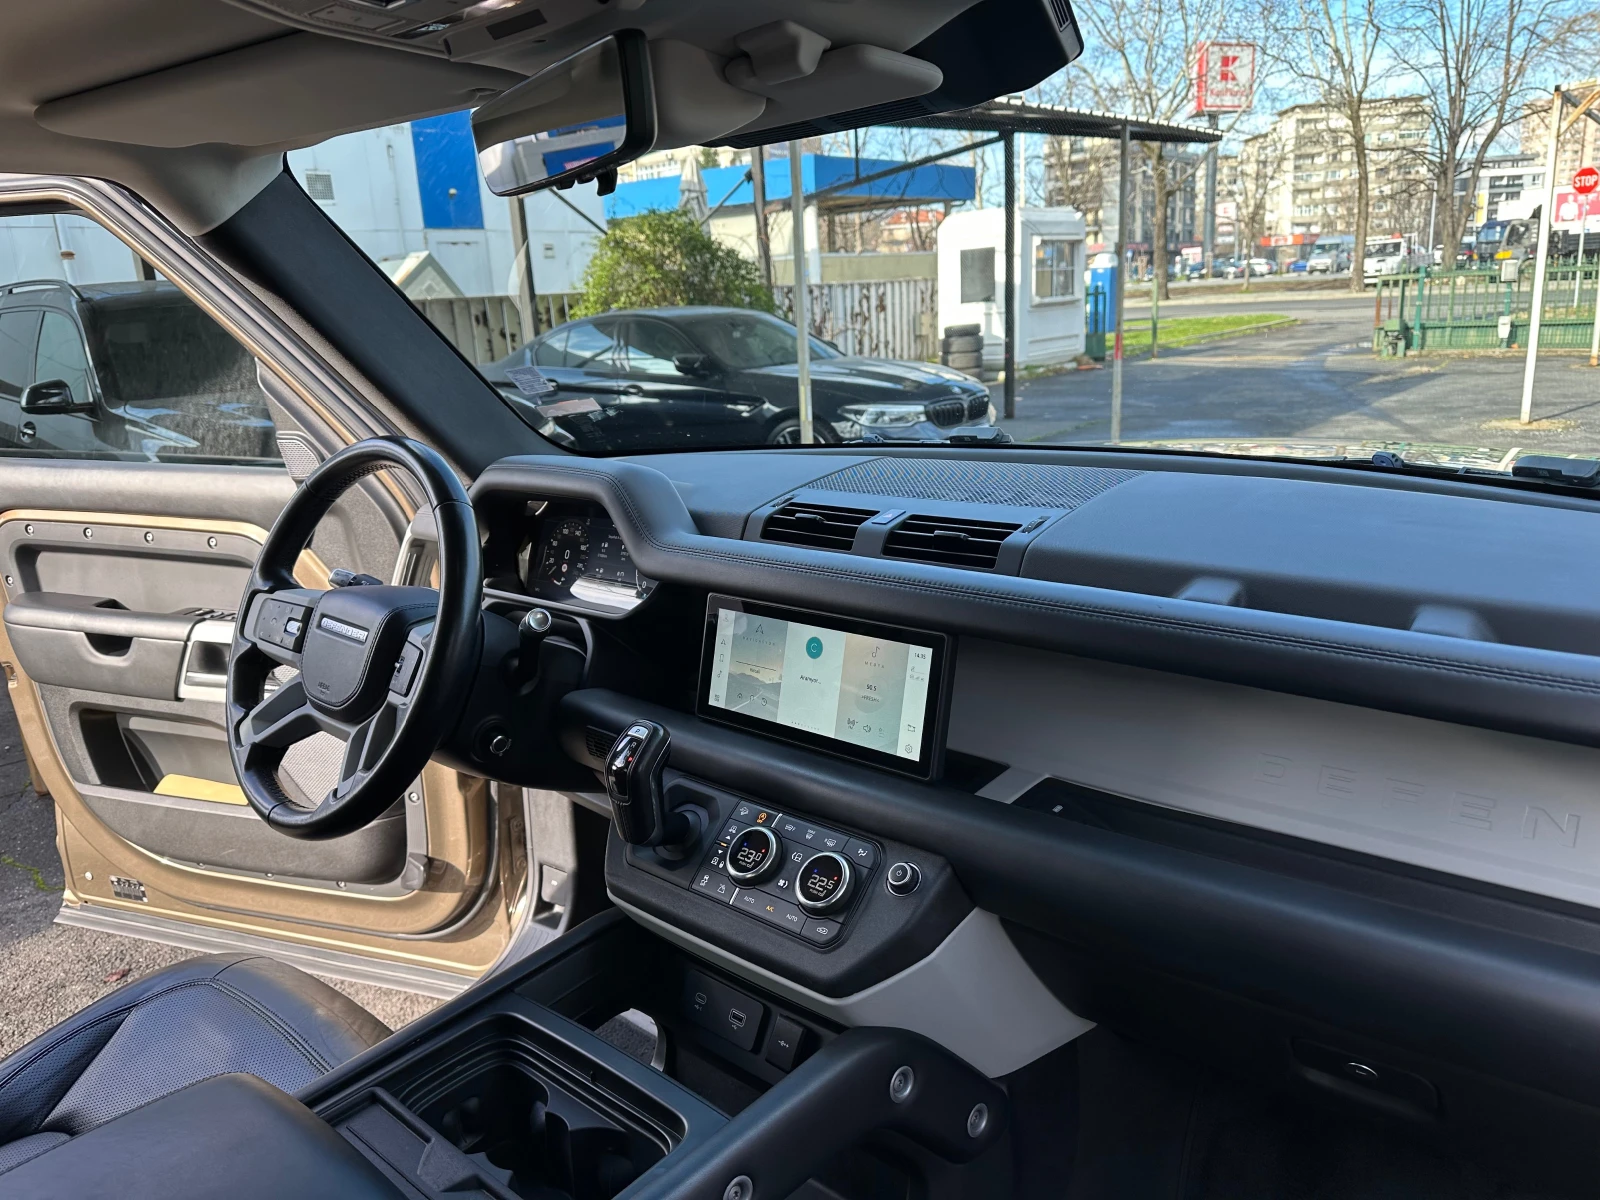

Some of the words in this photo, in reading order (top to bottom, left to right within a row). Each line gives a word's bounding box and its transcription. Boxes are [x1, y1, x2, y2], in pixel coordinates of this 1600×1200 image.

[1220, 55, 1239, 81] K
[1574, 174, 1599, 188] STOP
[564, 549, 570, 559] 0
[321, 618, 367, 641] DEFENDER
[810, 643, 818, 652] C
[736, 847, 763, 863] 23.0
[807, 874, 835, 891] 22.5
[743, 895, 755, 904] AUTO
[786, 913, 798, 922] AUTO
